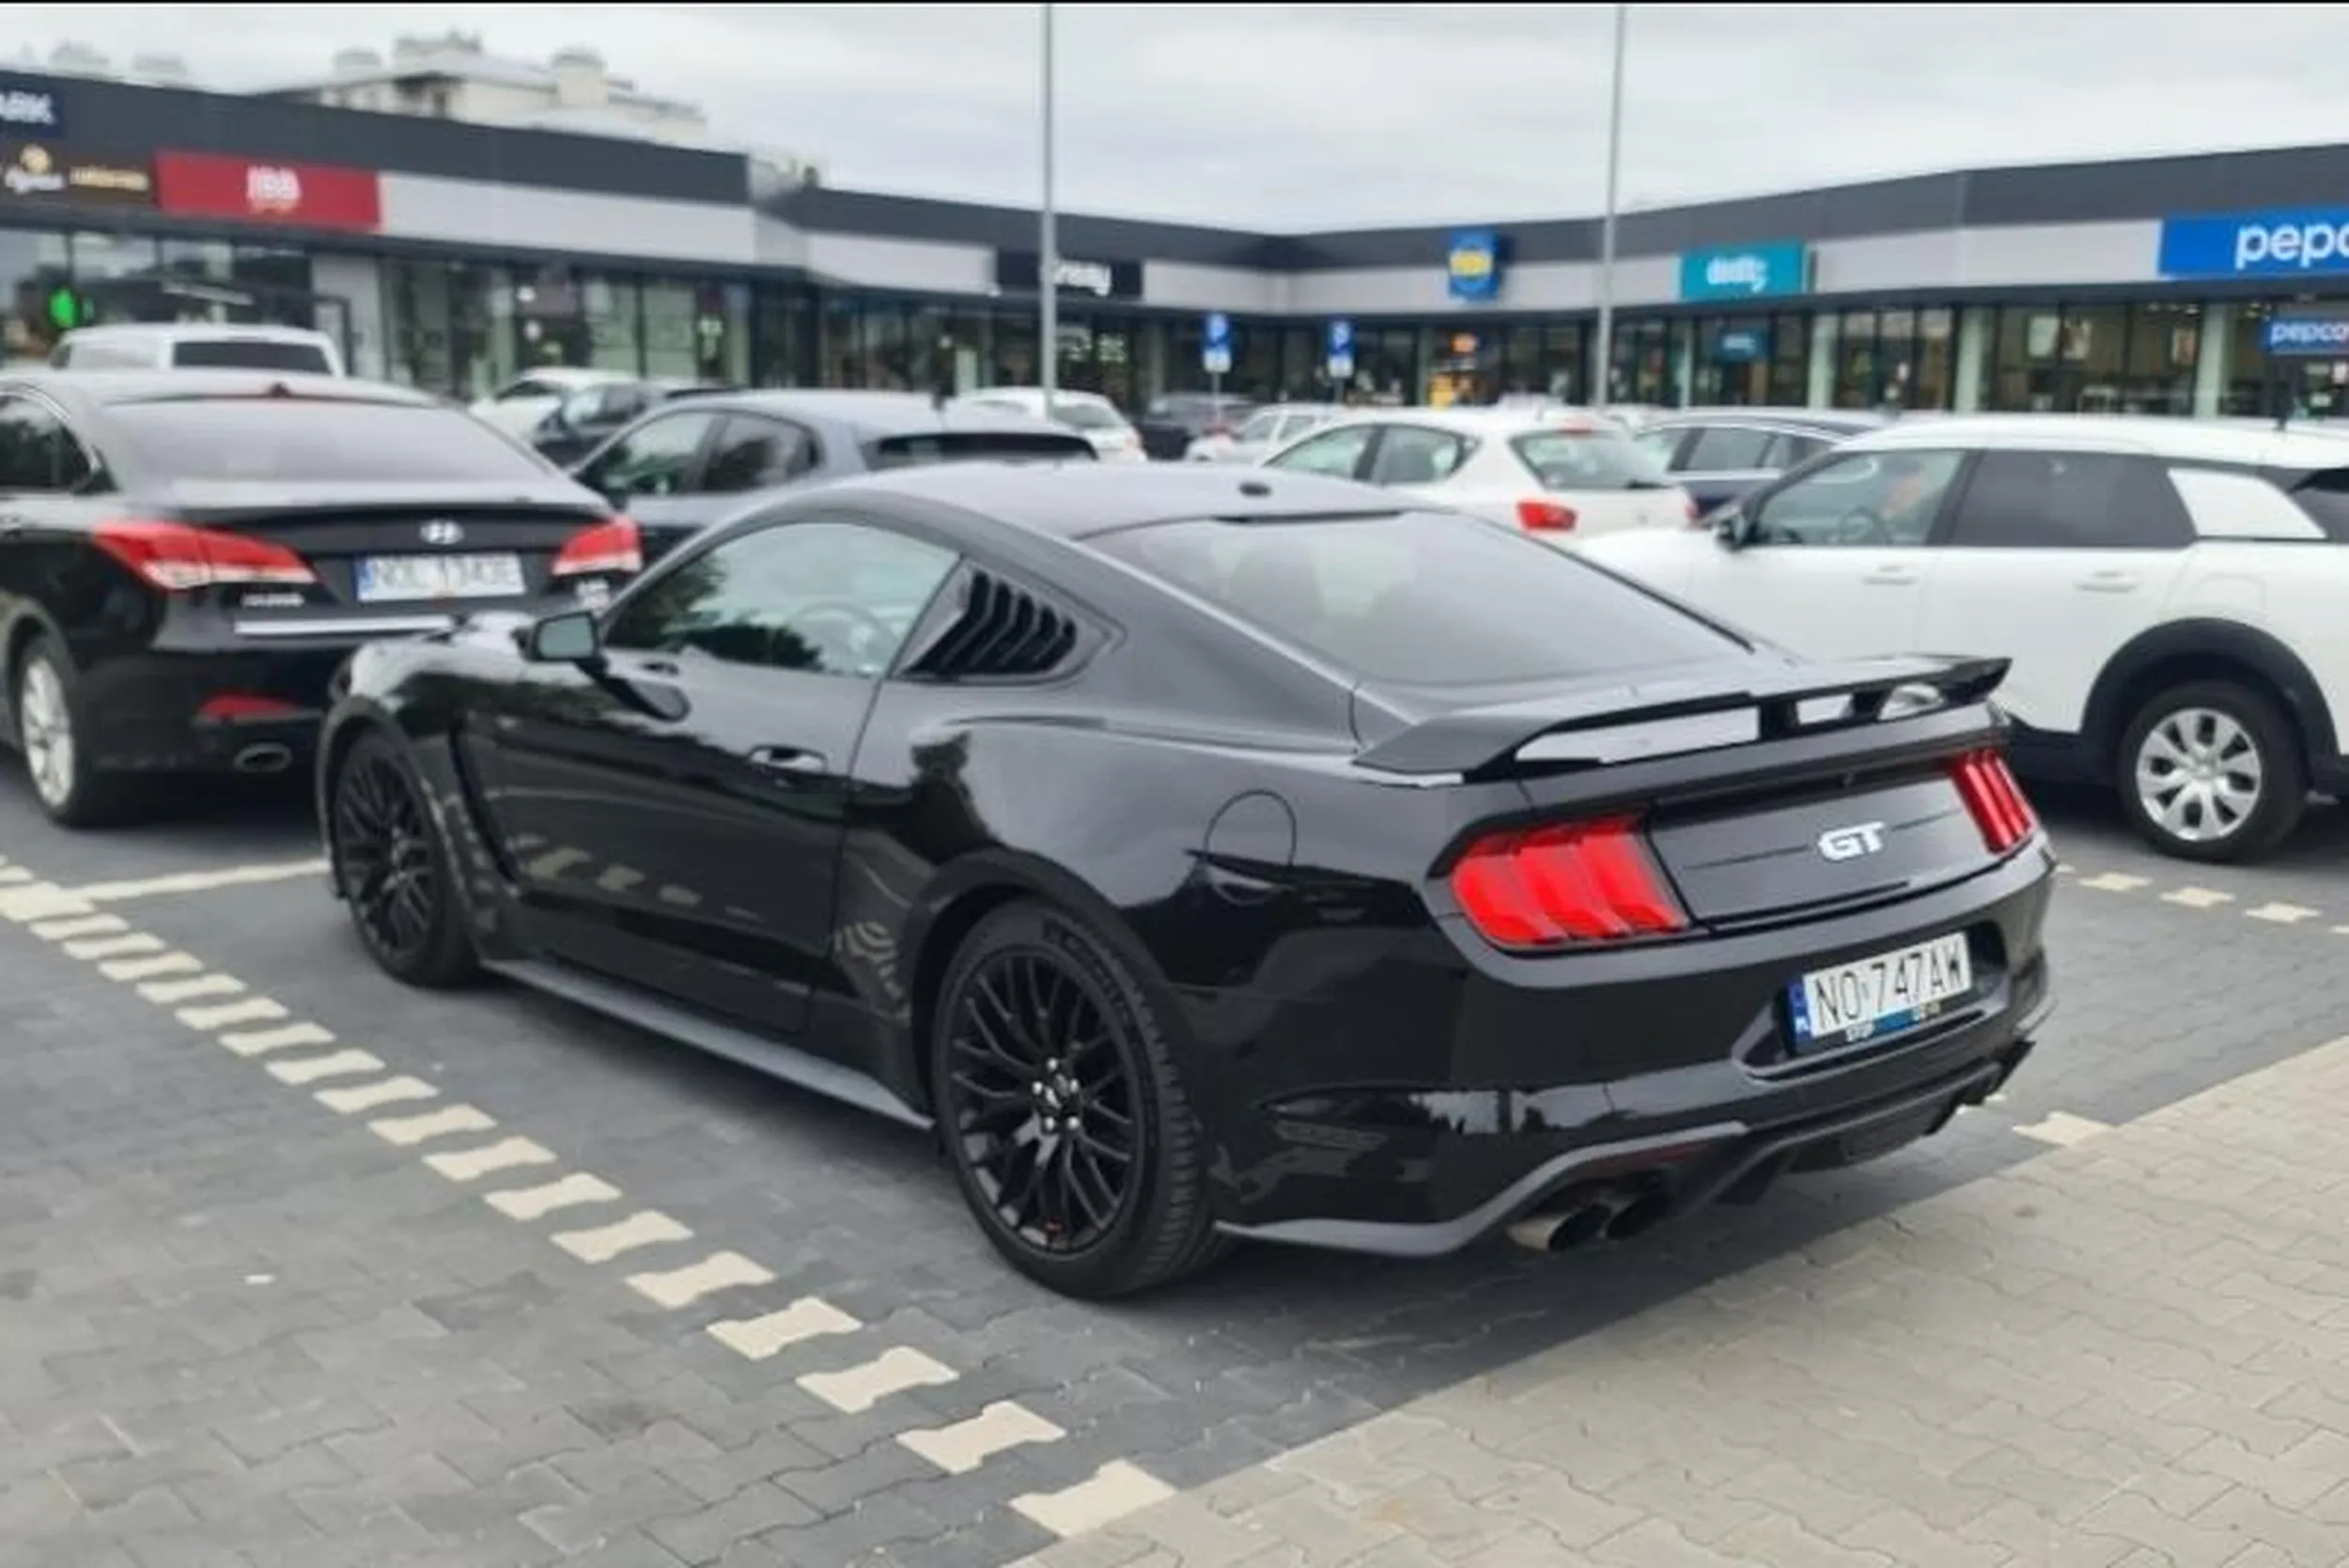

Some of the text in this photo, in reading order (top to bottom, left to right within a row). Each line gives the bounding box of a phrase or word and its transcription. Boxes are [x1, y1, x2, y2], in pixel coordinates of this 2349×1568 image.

[1818, 821, 1884, 861] GT
[1814, 941, 1963, 1032] NO 747AW
